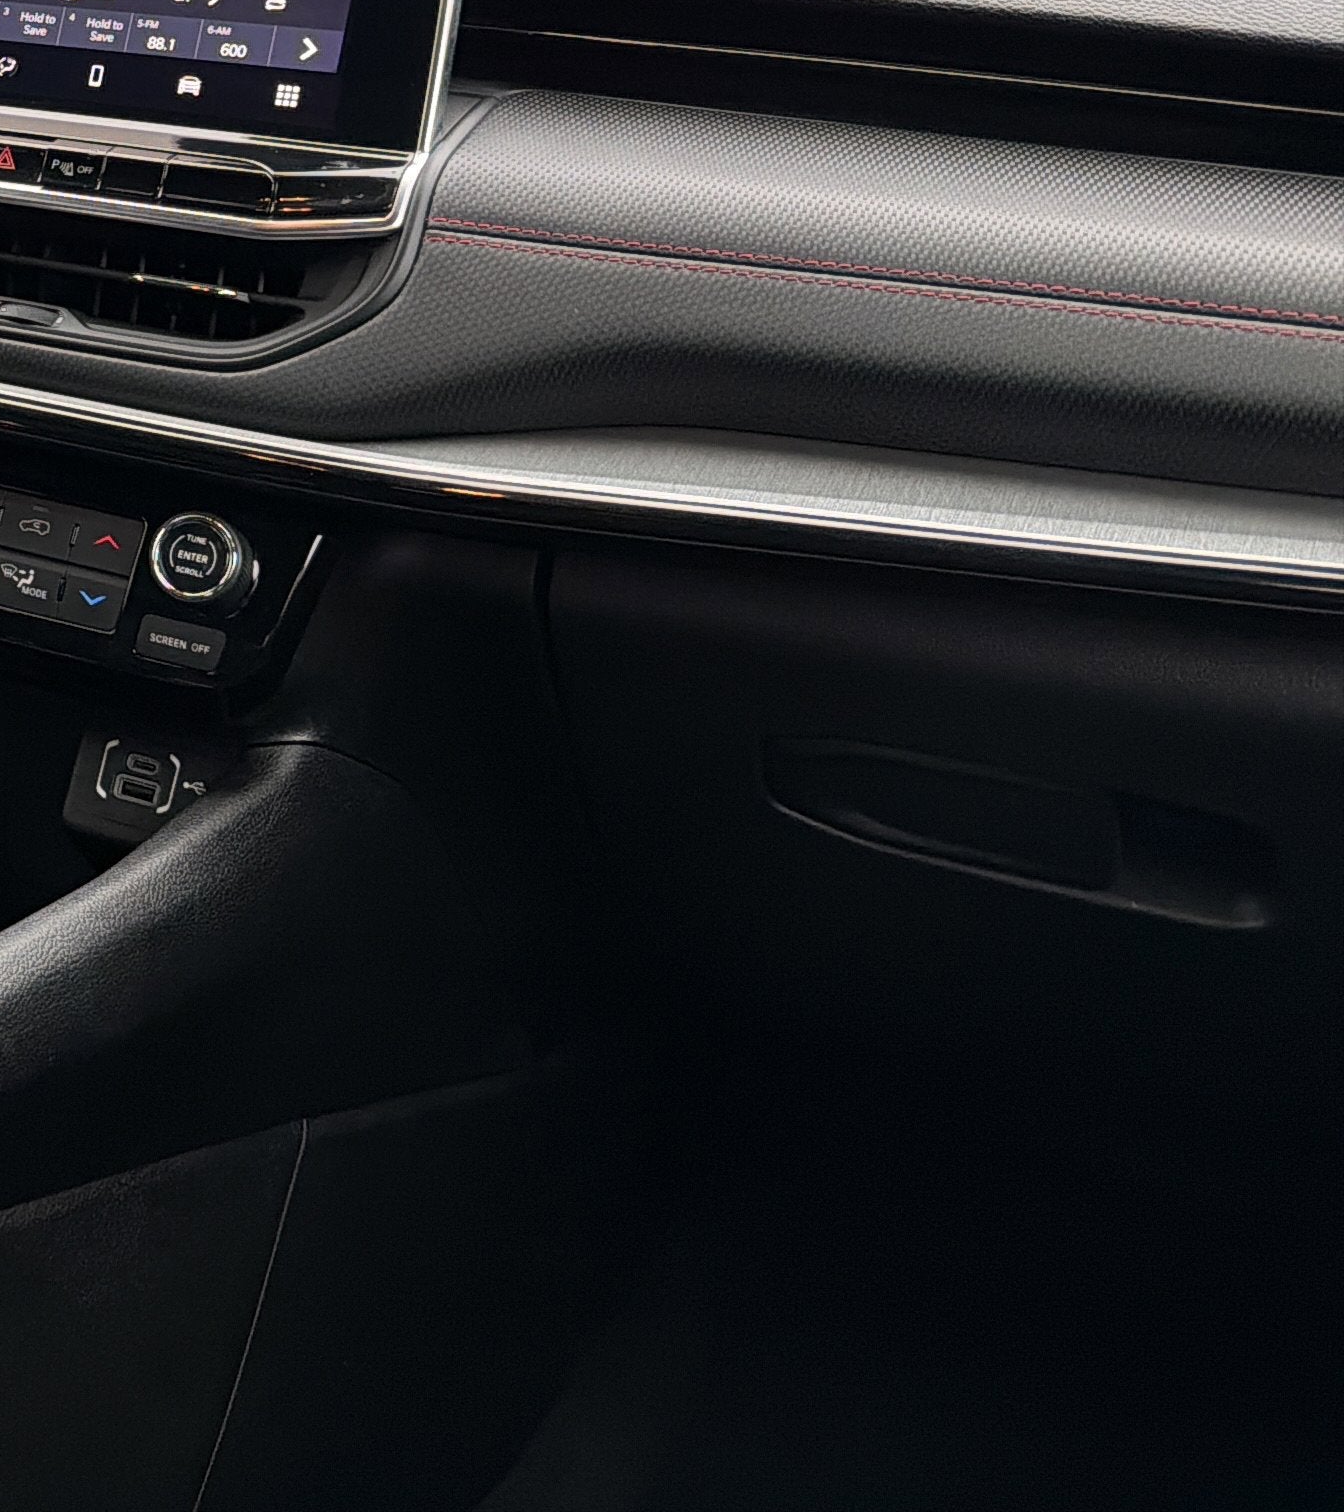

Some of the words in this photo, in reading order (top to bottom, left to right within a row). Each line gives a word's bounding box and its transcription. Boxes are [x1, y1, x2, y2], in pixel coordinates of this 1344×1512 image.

[19, 10, 43, 25] Hold
[44, 13, 57, 26] to
[86, 16, 110, 31] Hold
[111, 19, 125, 32] to
[23, 24, 48, 38] Save
[89, 30, 115, 44] Save
[146, 36, 176, 52] 88.1
[219, 42, 249, 59] 600
[76, 164, 94, 175] OFF
[186, 533, 209, 547] TUNE
[177, 549, 209, 565] ENTER
[174, 564, 205, 579] SCROLL
[20, 585, 49, 601] MODE
[149, 632, 188, 651] SCREEN
[190, 642, 212, 655] OFF
